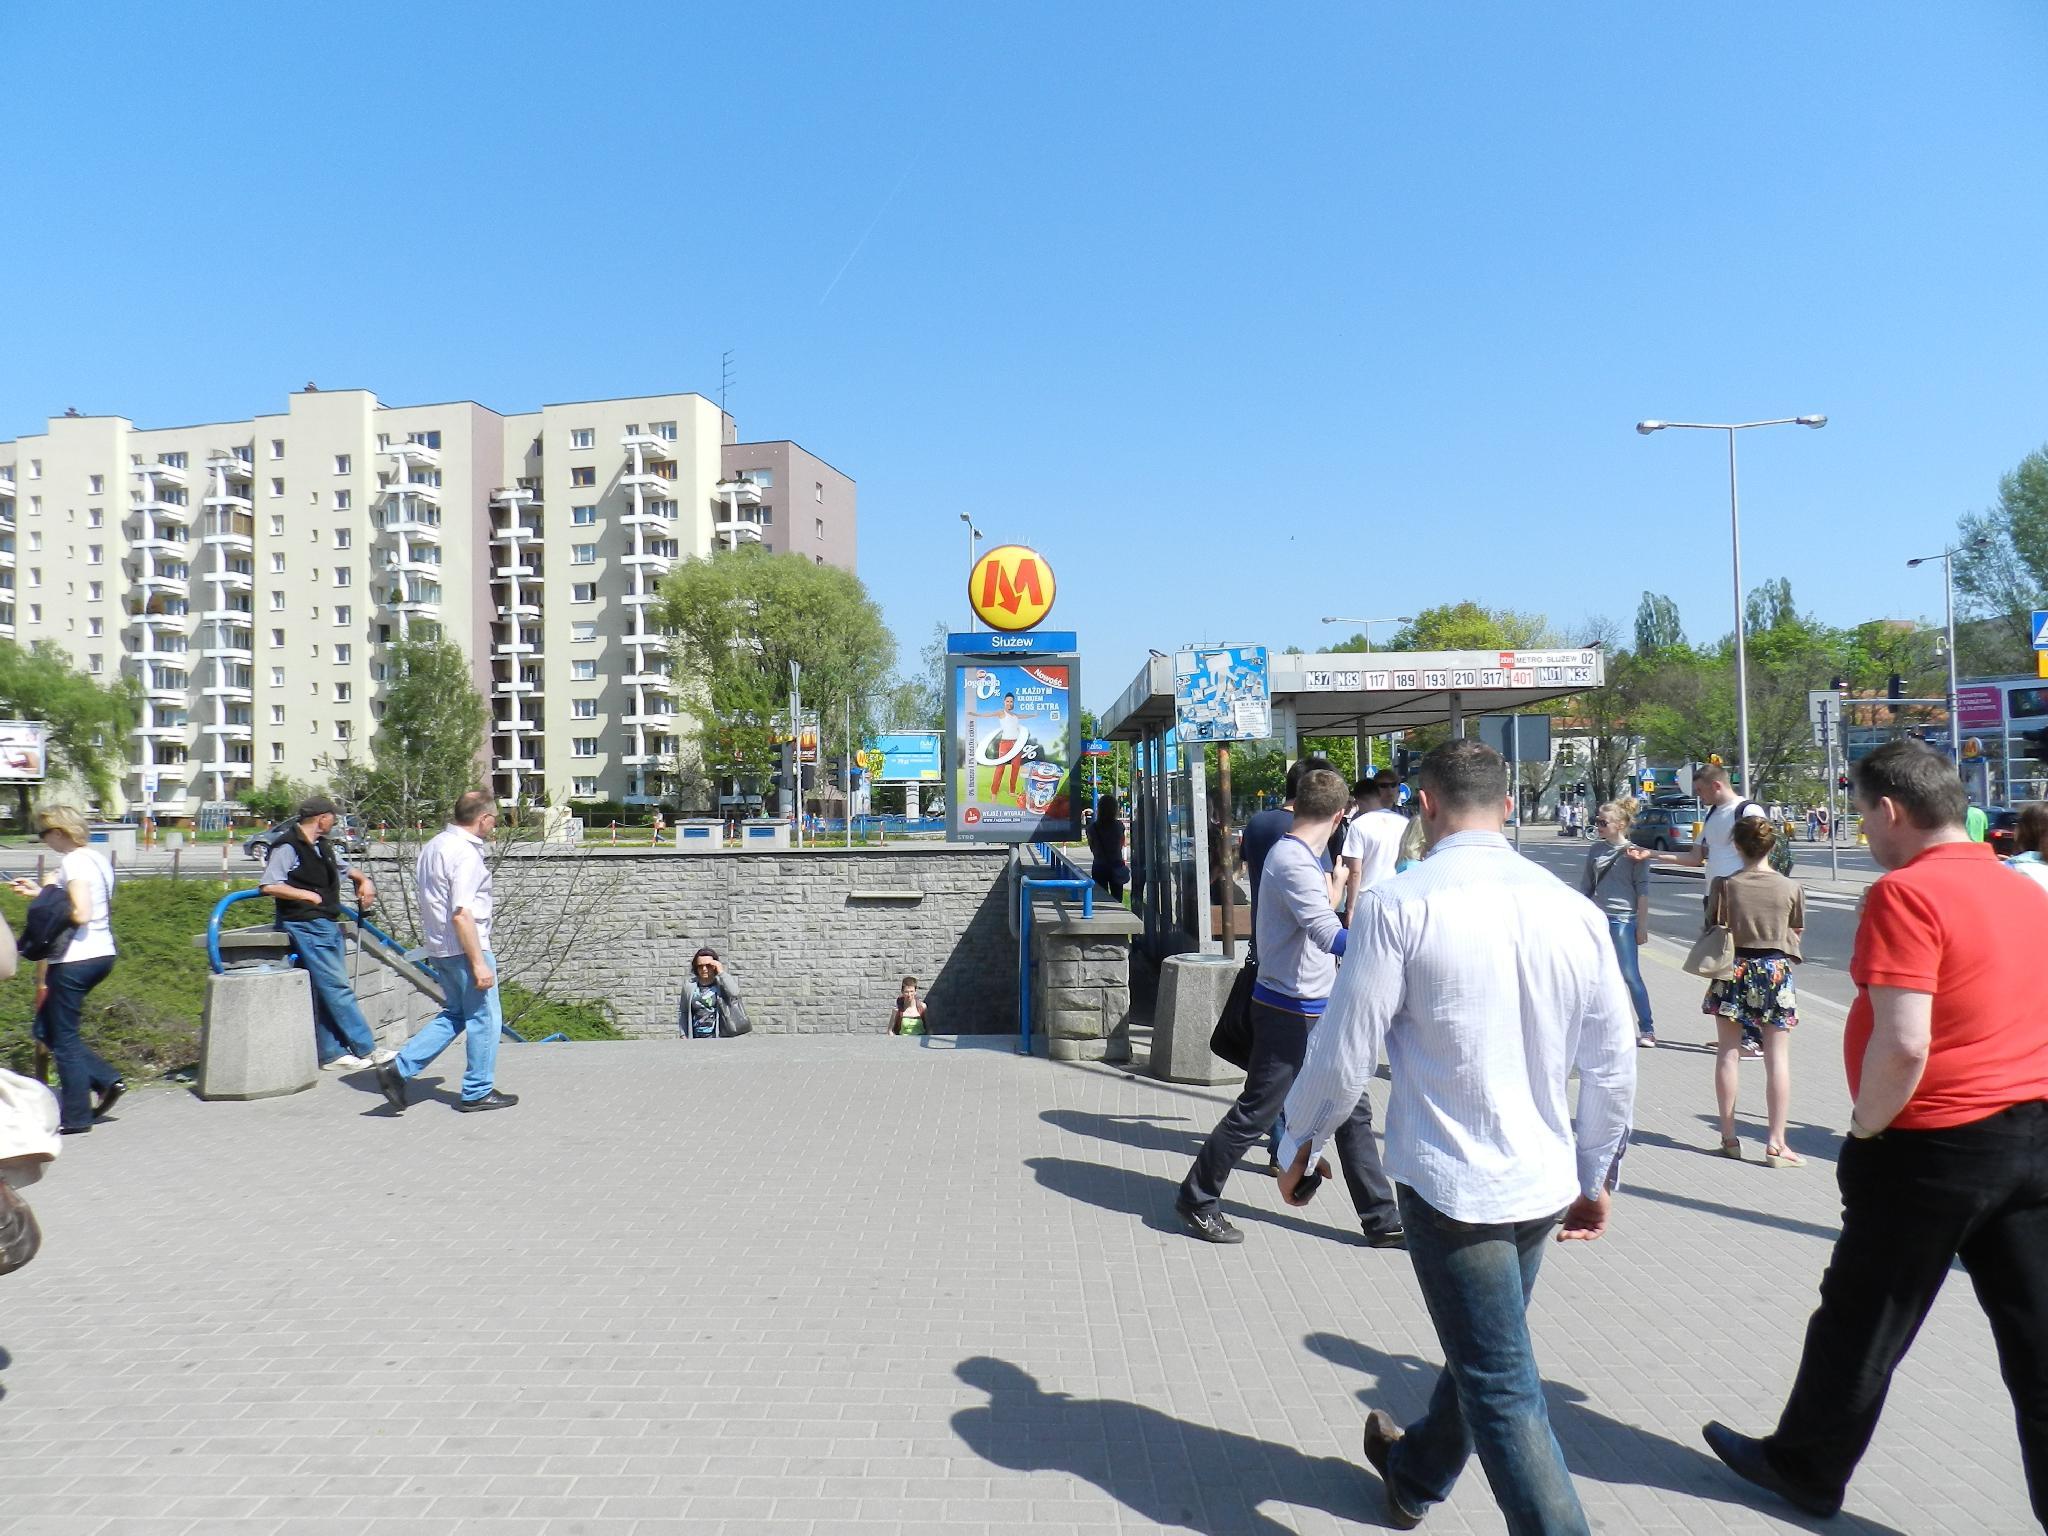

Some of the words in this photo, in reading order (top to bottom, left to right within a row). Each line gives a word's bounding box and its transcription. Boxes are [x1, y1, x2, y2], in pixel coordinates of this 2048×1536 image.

[991, 635, 1034, 648] Służew
[1515, 656, 1543, 664] METRO
[1581, 652, 1594, 665] 02
[1033, 668, 1063, 687] Nowość
[1369, 674, 1385, 687] 117
[1396, 674, 1415, 687] 189
[1425, 673, 1446, 687] 193
[1454, 672, 1474, 685] 210
[1483, 672, 1502, 685] 317
[1513, 672, 1532, 685] 401
[1540, 667, 1562, 681] N01
[1567, 668, 1590, 681] N33
[1020, 702, 1034, 711] COŚ
[1036, 702, 1060, 711] EXTRA
